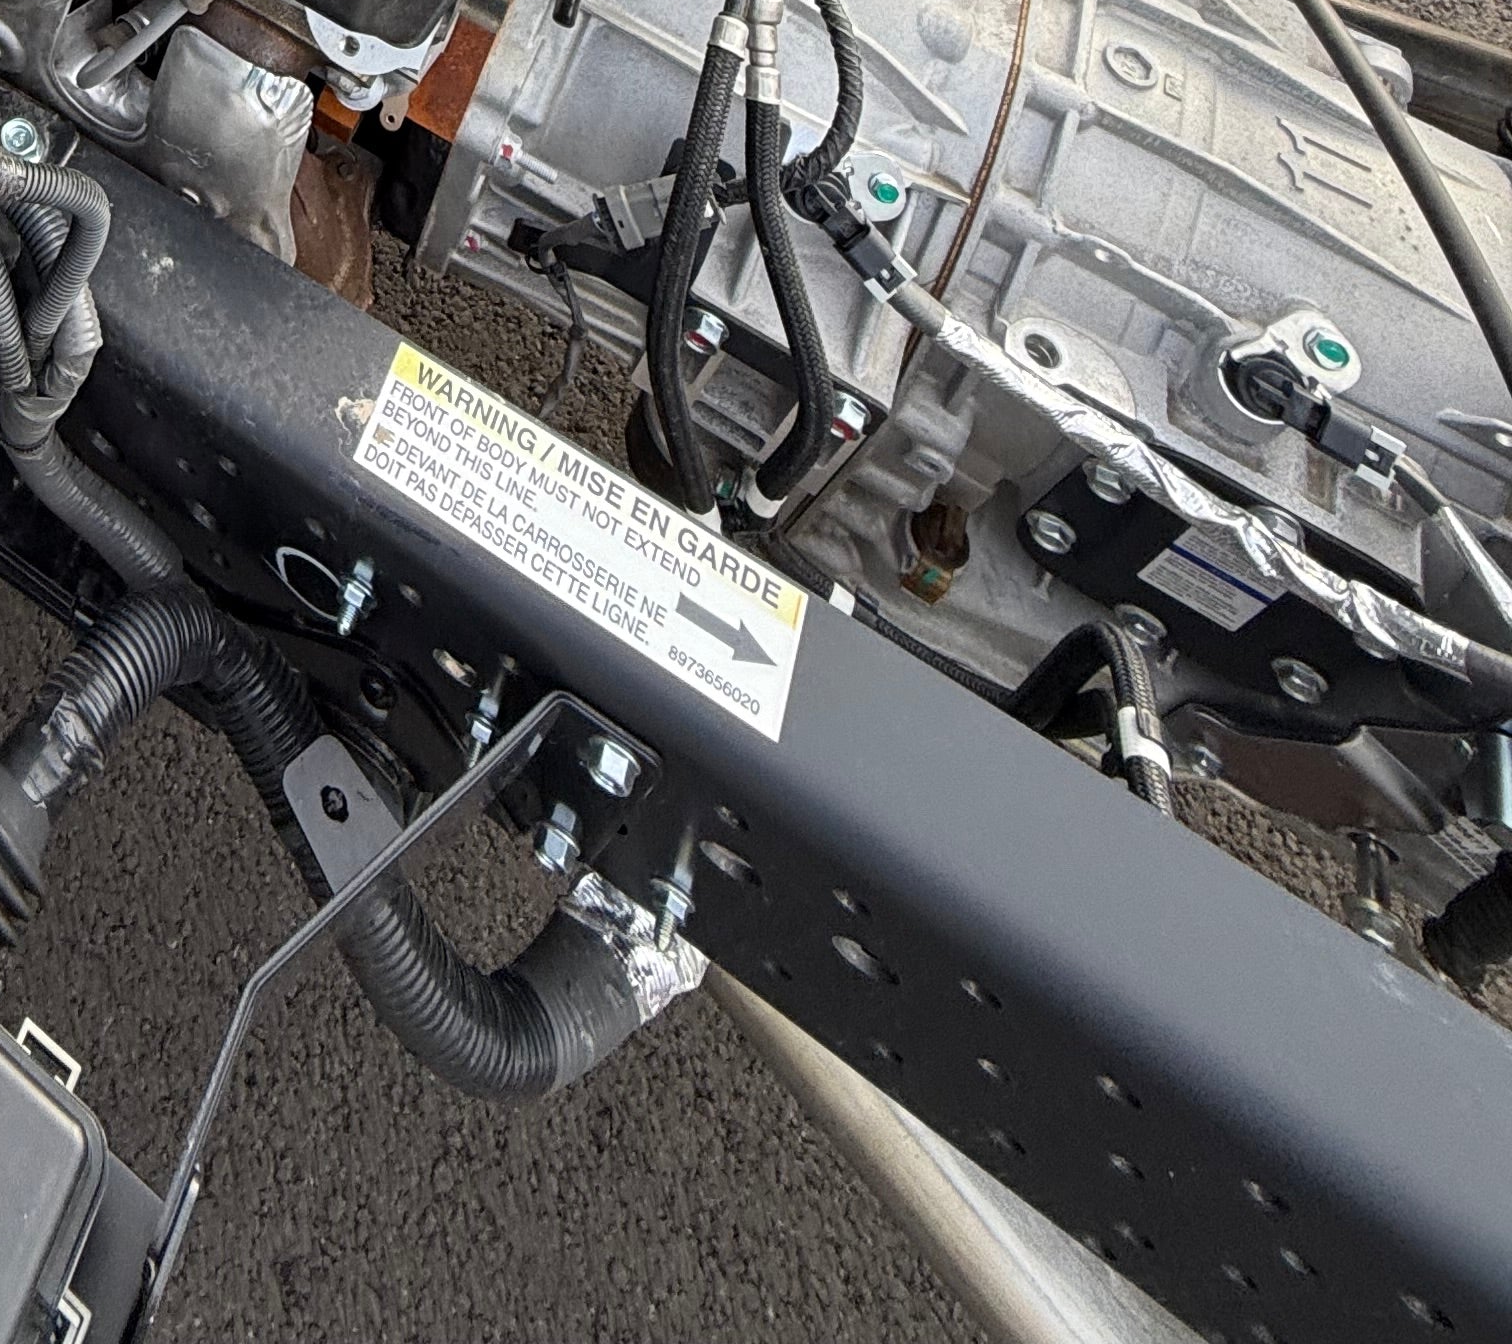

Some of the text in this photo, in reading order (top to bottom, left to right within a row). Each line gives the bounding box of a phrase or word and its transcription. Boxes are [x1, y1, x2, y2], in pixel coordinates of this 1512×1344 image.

[364, 443, 649, 645] DOIT PAS DÉPASSER CETTE LIGNE.
[382, 400, 538, 512] BEYOND THIS LINE.
[390, 380, 701, 588] FRONT OF BODY MUST NOT EXTEND
[395, 438, 461, 489] DEVANT
[461, 480, 487, 508] DE
[487, 497, 508, 524] LA
[512, 514, 639, 608] CARROSSERIE
[640, 595, 668, 627] NE
[417, 361, 782, 609] WARNING / MISE EN GARDE
[668, 645, 761, 716] 8973656020
